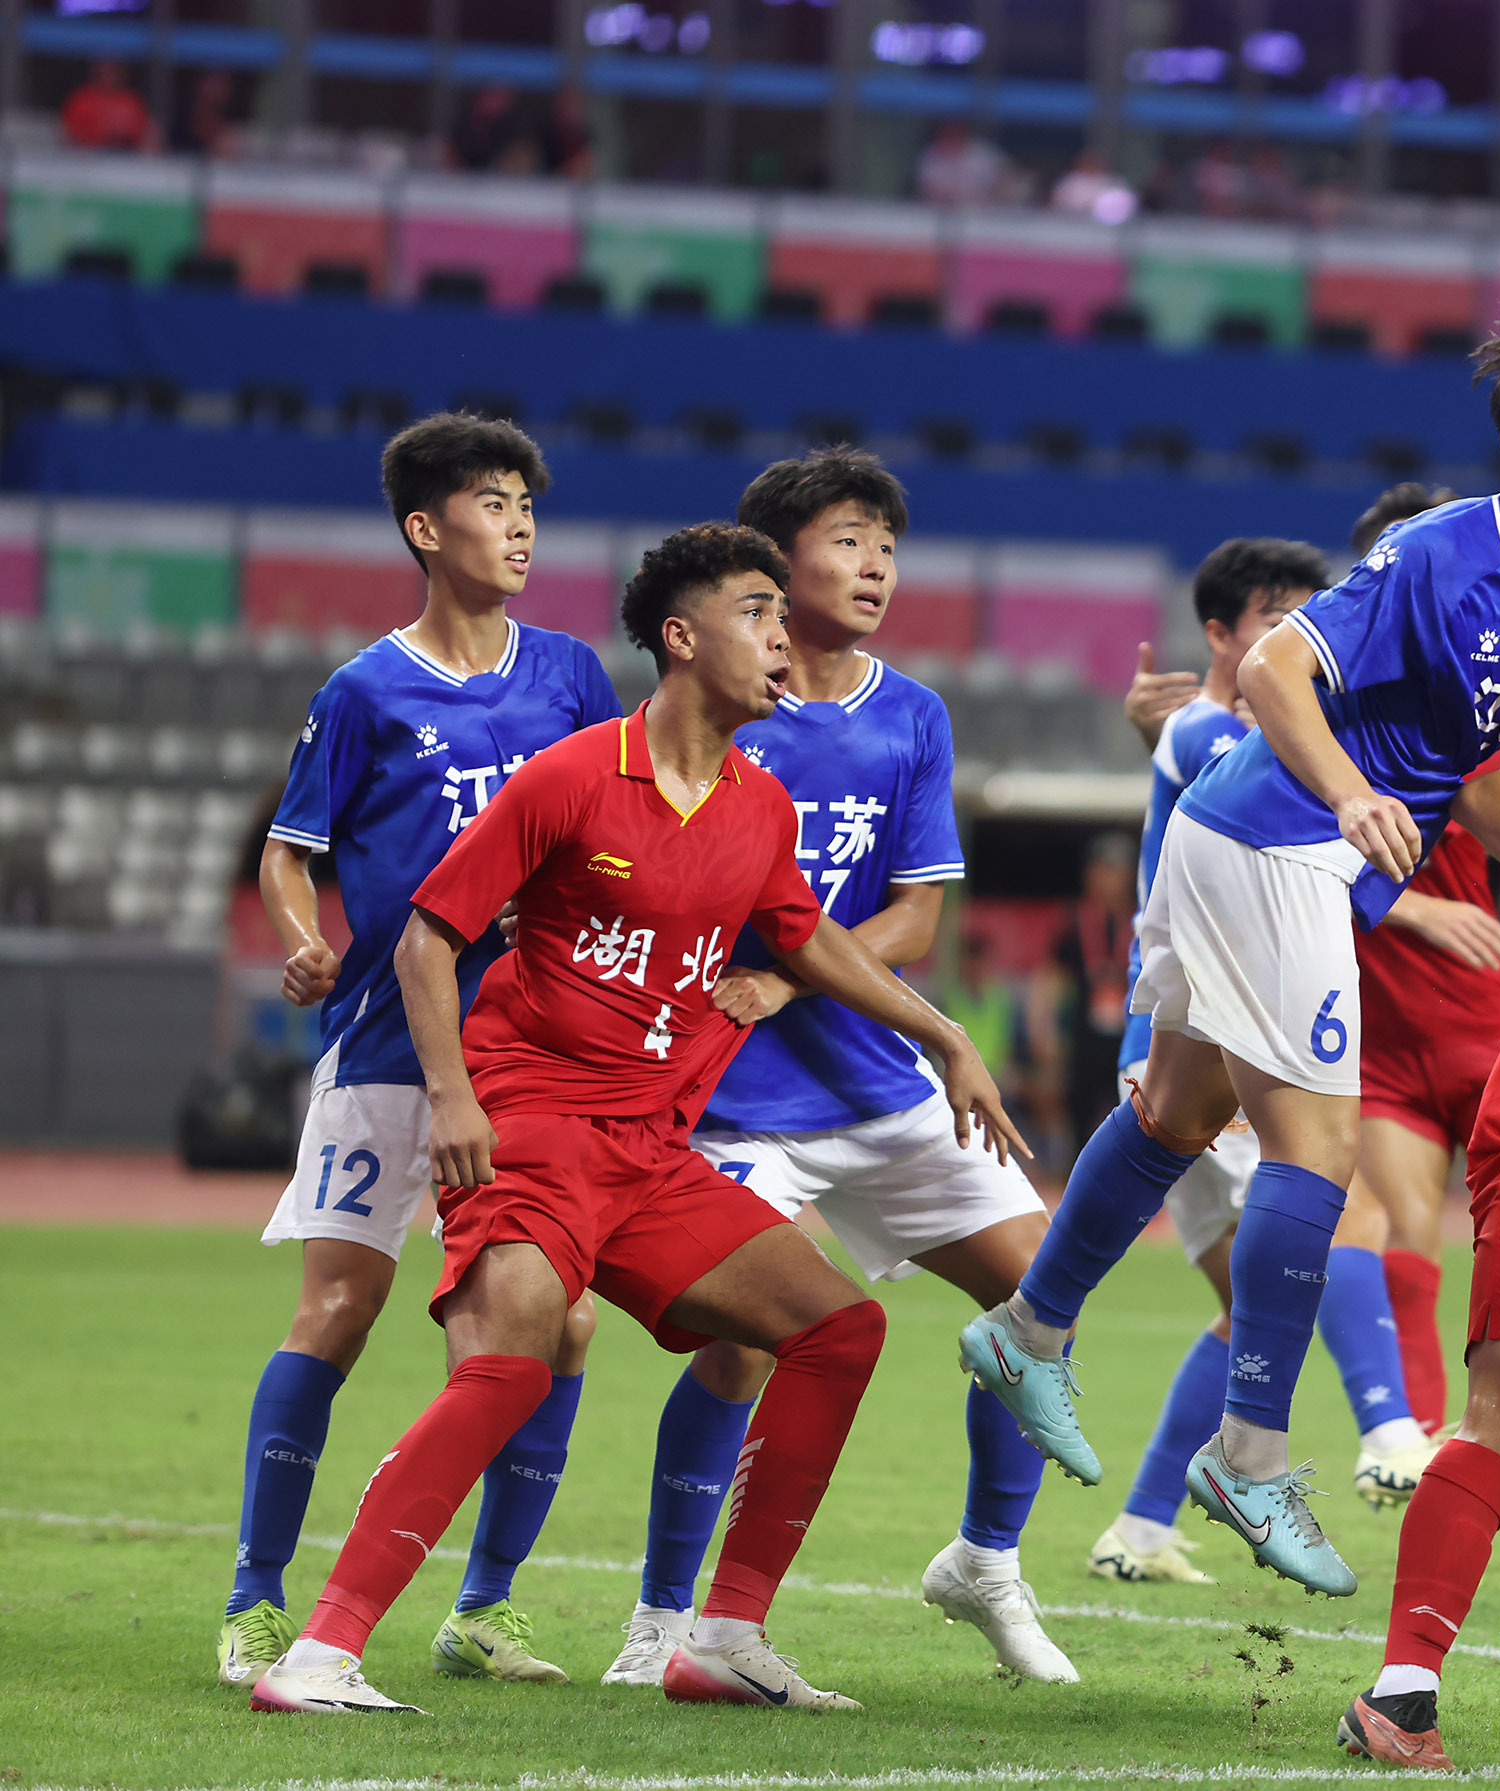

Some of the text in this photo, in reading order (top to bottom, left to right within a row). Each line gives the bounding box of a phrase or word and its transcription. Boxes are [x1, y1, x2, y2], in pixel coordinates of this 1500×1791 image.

[415, 741, 449, 759] KELME
[441, 749, 544, 834] 江
[587, 862, 632, 879] LI-NING
[572, 915, 724, 992] 湖北
[644, 1003, 673, 1059] 4
[1310, 989, 1347, 1064] 6
[314, 1144, 381, 1217] 12
[1231, 1369, 1271, 1383] KELME
[663, 1473, 721, 1495] KELME
